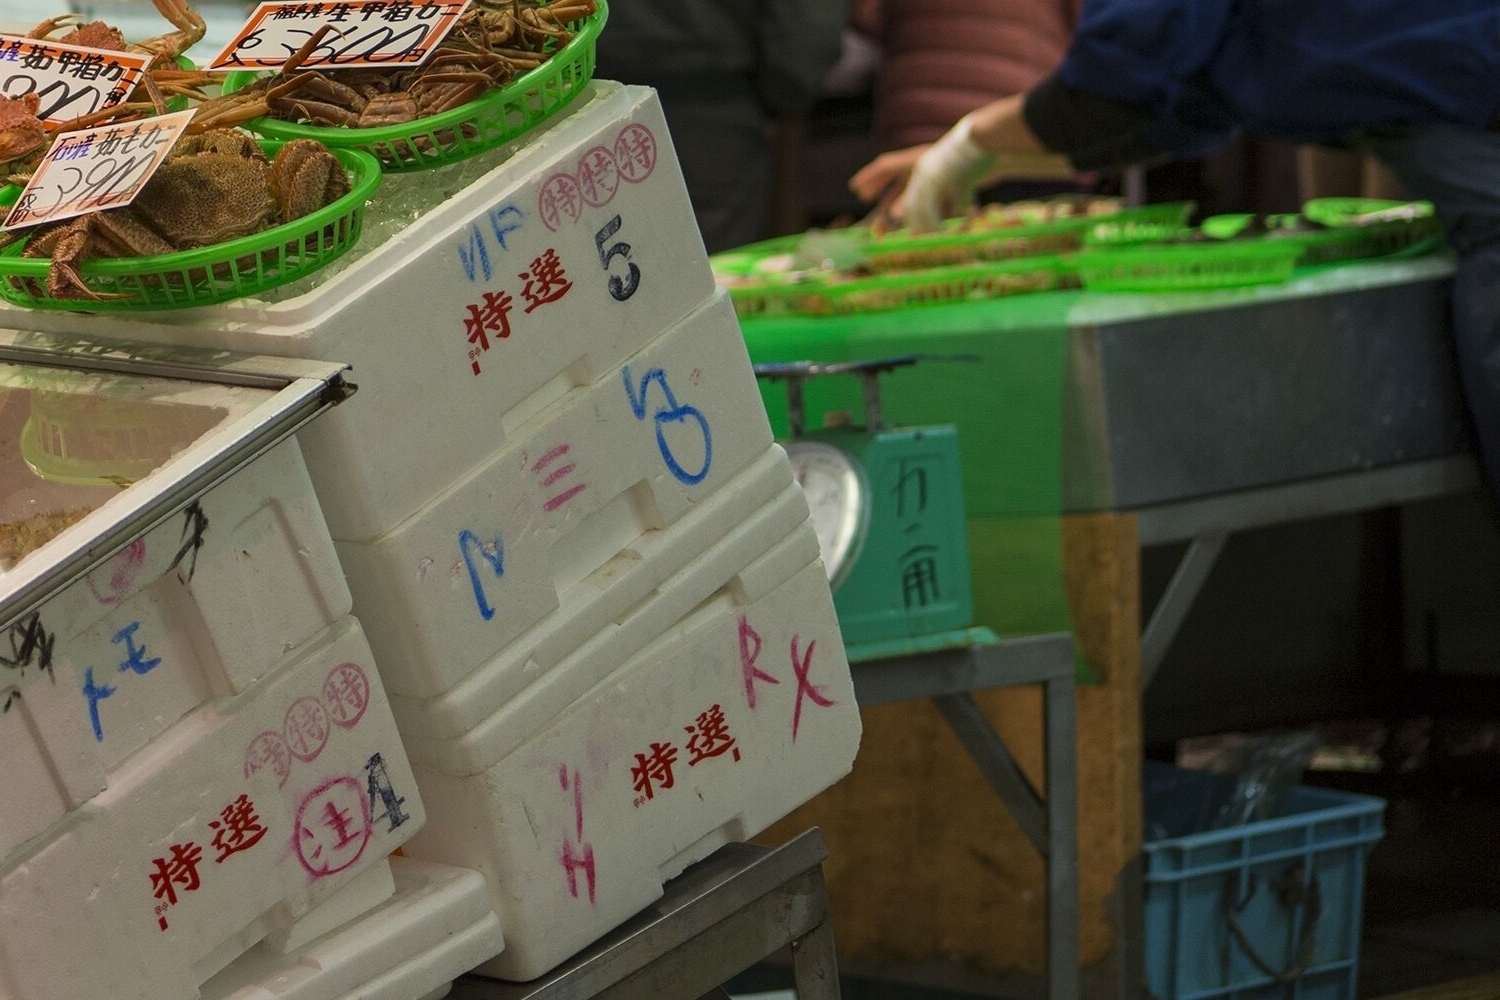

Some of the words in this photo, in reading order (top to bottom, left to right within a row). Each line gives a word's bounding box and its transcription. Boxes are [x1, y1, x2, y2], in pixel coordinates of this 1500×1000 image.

[463, 248, 574, 352] 特選
[595, 214, 641, 302] 5
[631, 704, 738, 800] 特選
[149, 794, 269, 905] 特選
